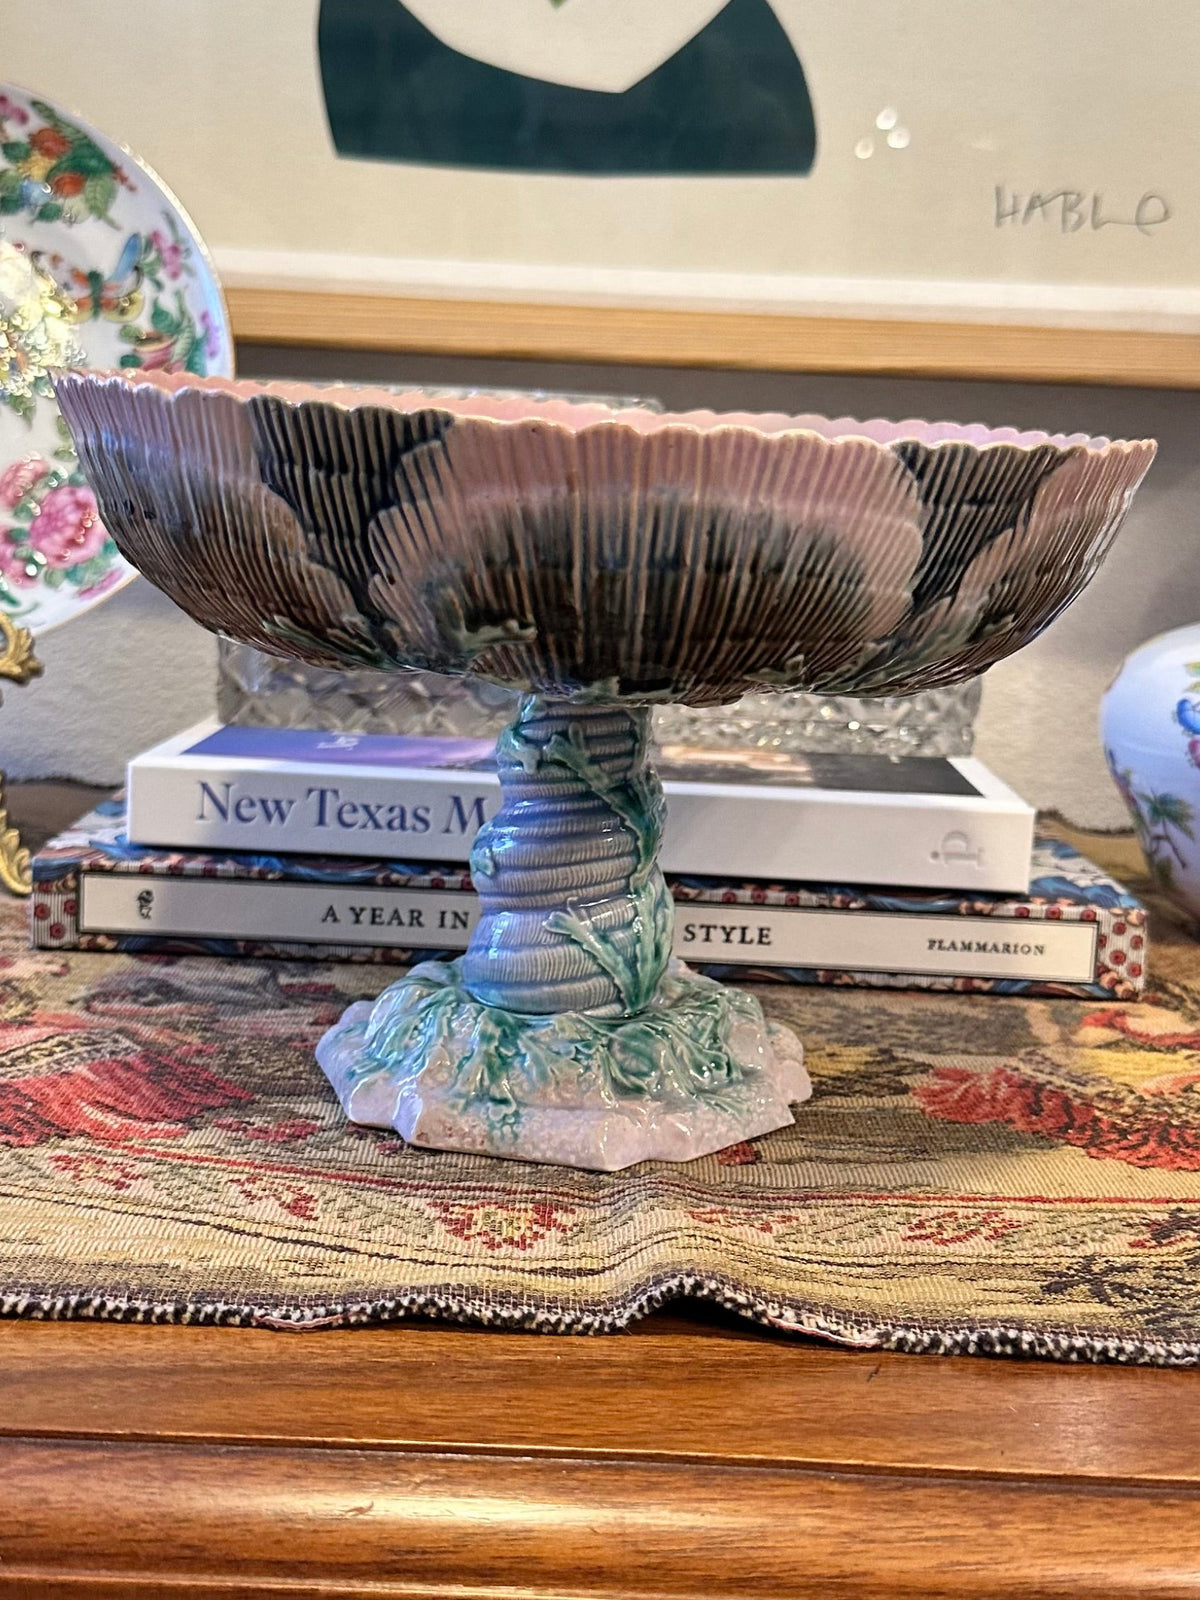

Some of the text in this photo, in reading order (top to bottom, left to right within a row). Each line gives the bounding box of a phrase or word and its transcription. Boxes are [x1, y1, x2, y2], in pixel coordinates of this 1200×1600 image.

[196, 780, 296, 825] New
[307, 787, 430, 835] Texas
[321, 904, 773, 946] A YEAR IN STYLE
[927, 938, 1046, 957] FLAMMARION
